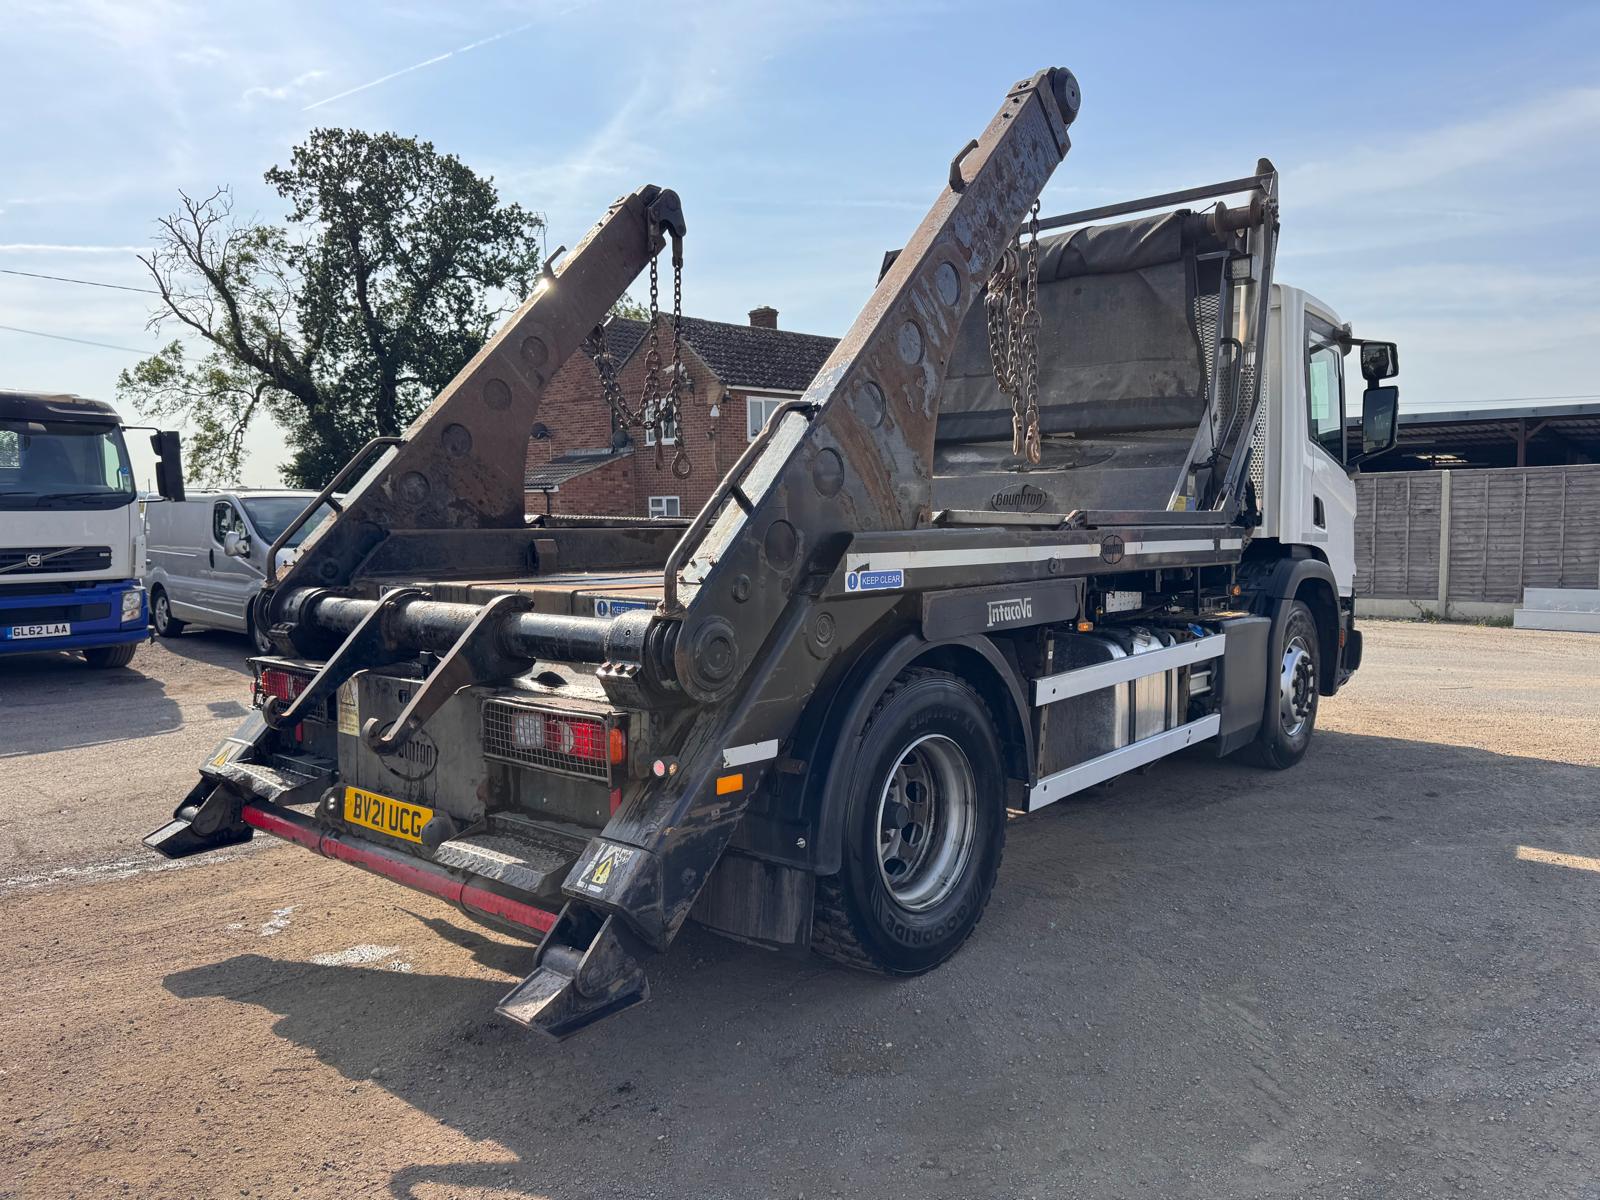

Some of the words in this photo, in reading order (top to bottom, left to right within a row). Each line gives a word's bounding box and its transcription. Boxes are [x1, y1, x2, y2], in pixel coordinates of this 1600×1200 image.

[862, 576, 879, 585] KEEP
[880, 575, 901, 584] CLEAR
[13, 626, 43, 637] GL62
[46, 624, 68, 635] LAA
[353, 792, 385, 828] BV21
[389, 805, 421, 838] UCG
